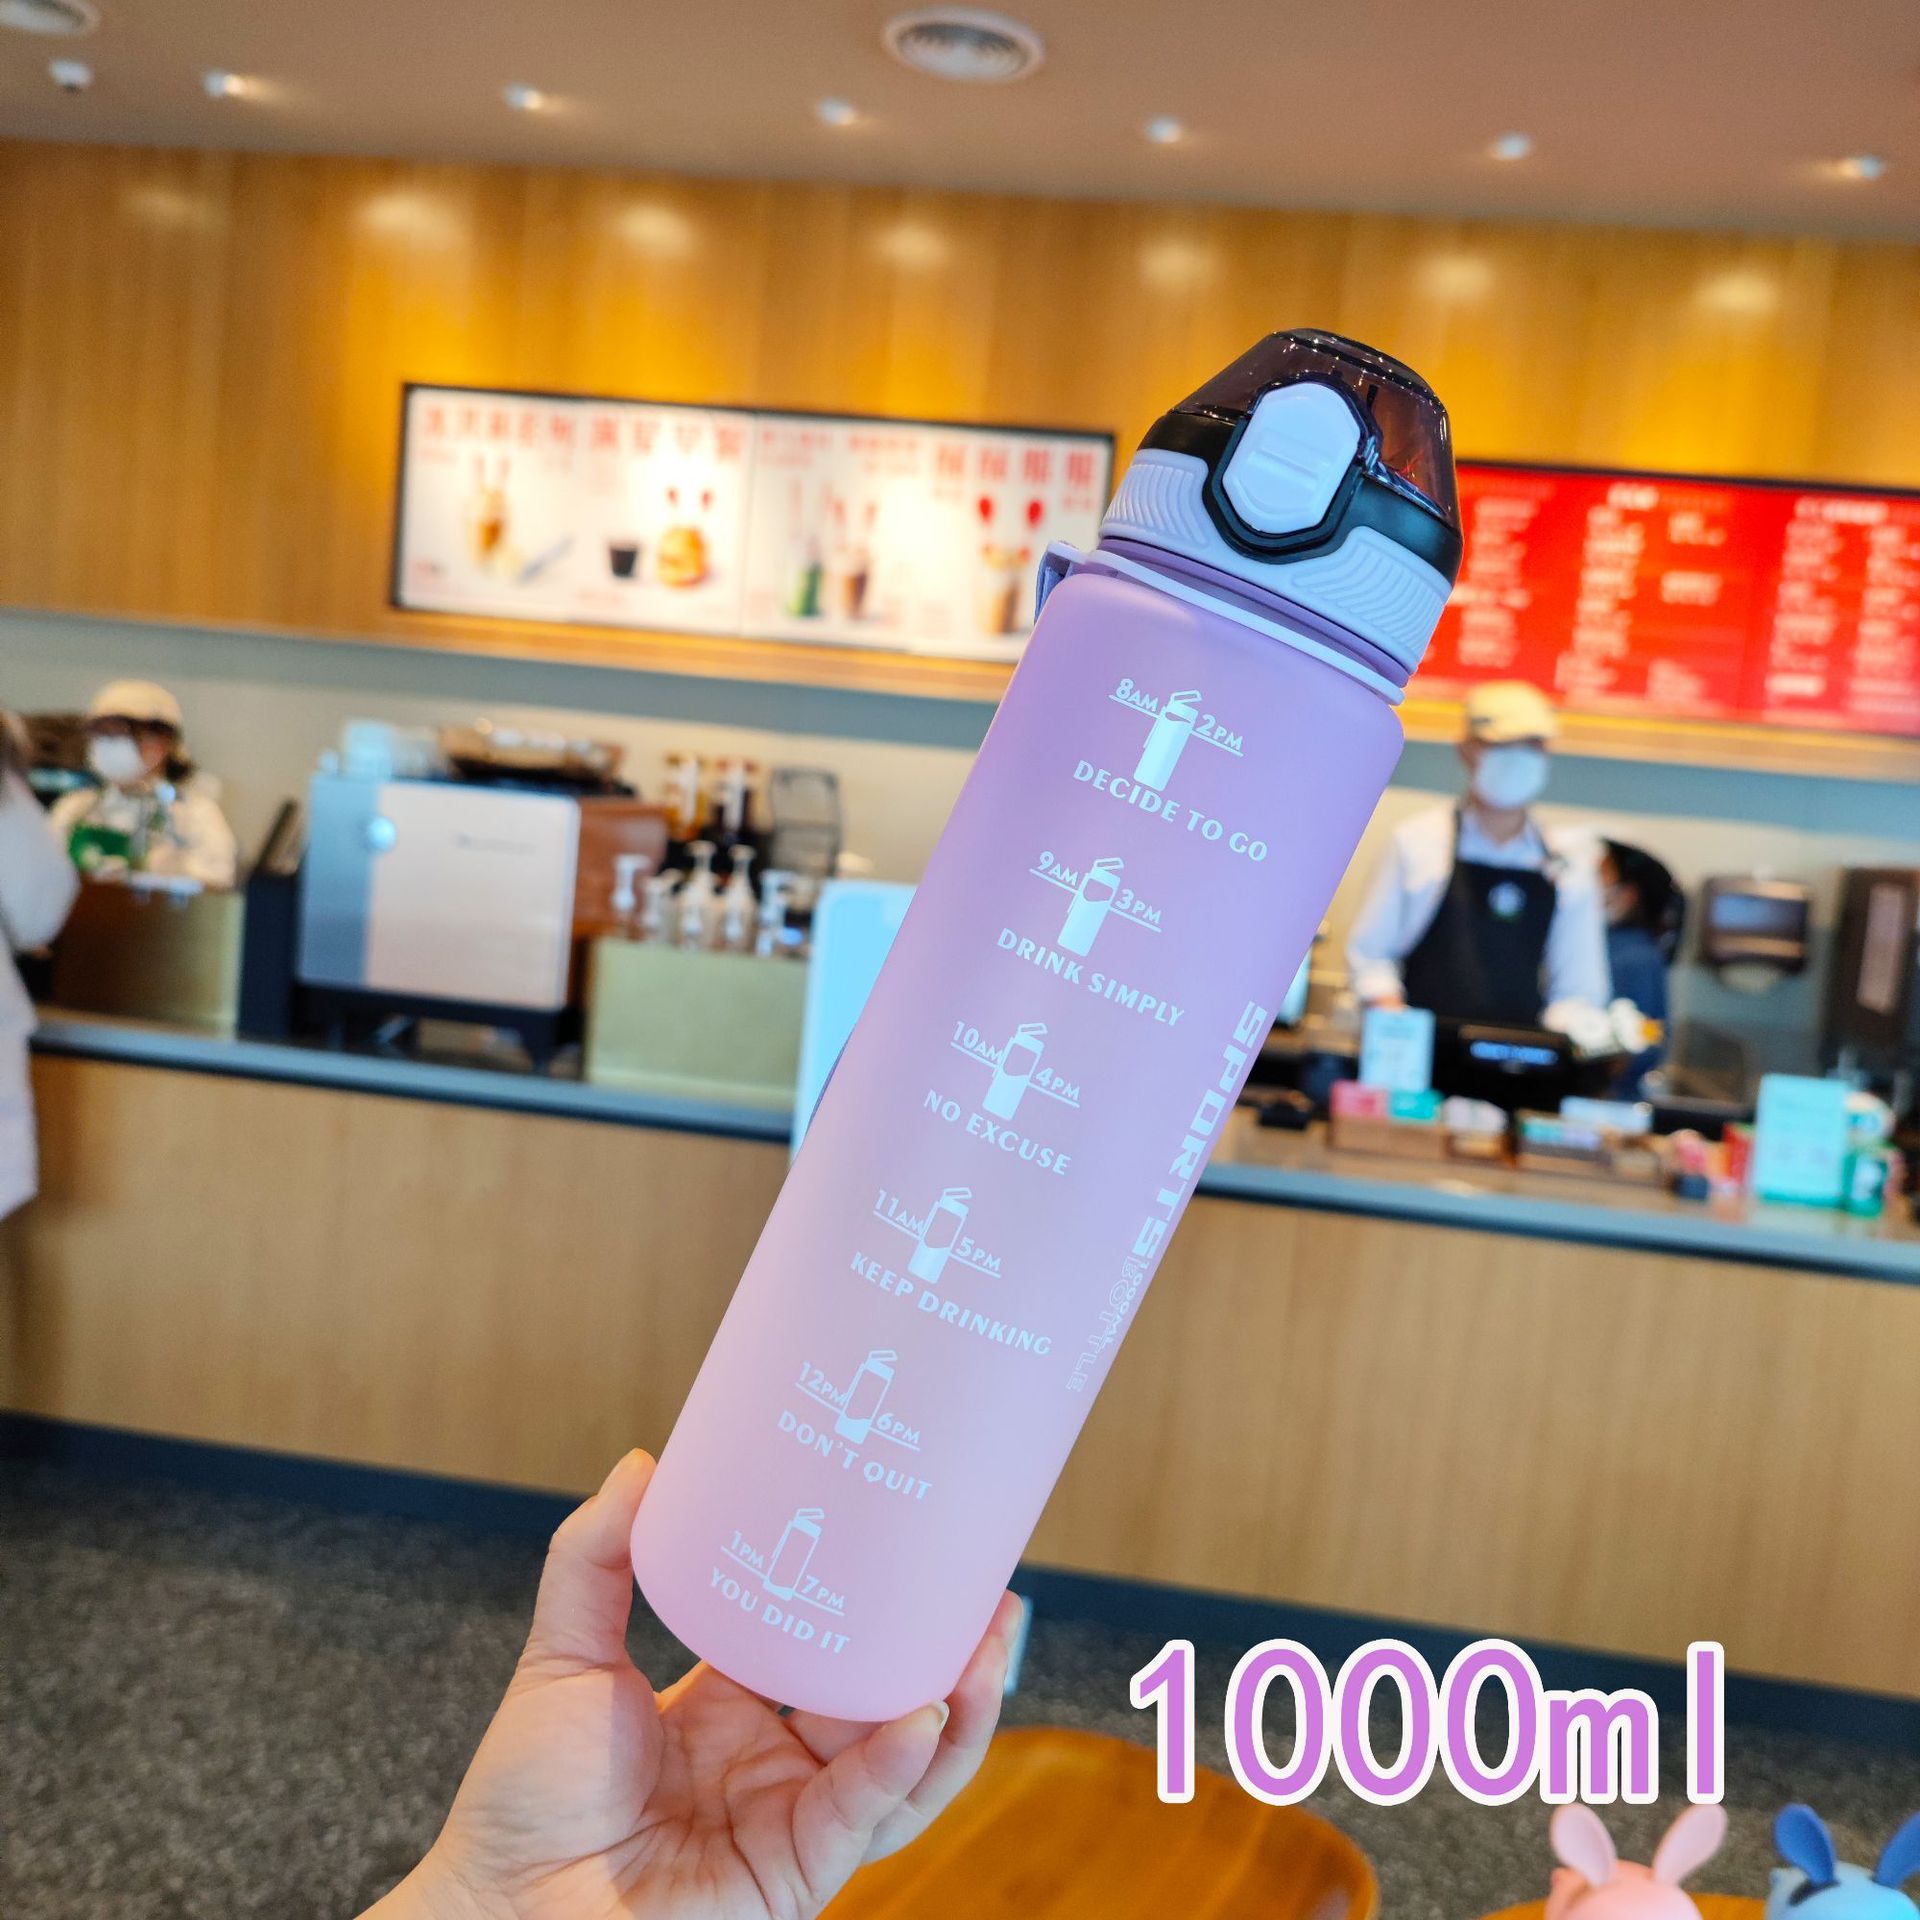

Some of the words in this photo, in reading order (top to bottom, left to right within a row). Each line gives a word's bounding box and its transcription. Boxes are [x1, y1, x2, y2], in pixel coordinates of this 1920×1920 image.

[1115, 677, 1159, 713] 8AM
[1198, 714, 1244, 752] 2PM
[1072, 760, 1181, 823] DECIDE
[1188, 809, 1224, 842] TO
[1229, 831, 1269, 862] GO
[1038, 851, 1079, 887] 9AM
[1116, 888, 1162, 925] 3PM
[996, 927, 1081, 985] DRINK
[1088, 972, 1186, 1027] SIMPLY
[952, 1020, 1005, 1064] 10AM
[1035, 1066, 1080, 1101] 4PM
[923, 1089, 961, 1122] NO
[965, 1112, 1073, 1176] EXCUSE
[1131, 1001, 1268, 1259] SPORTS
[873, 1189, 926, 1234] 11AM
[955, 1236, 1002, 1272] 5PM
[849, 1251, 914, 1298] KEEP
[917, 1289, 1053, 1355] DRINKING
[1066, 1255, 1138, 1392] BOTTLE
[799, 1361, 850, 1407] 12PM
[876, 1412, 921, 1445] 6PM
[863, 1461, 933, 1500] QUIT
[730, 1530, 765, 1569] 1PM
[709, 1566, 758, 1612] YOU
[761, 1604, 816, 1641] DID
[819, 1630, 851, 1655] IT
[801, 1575, 845, 1610] 7PM
